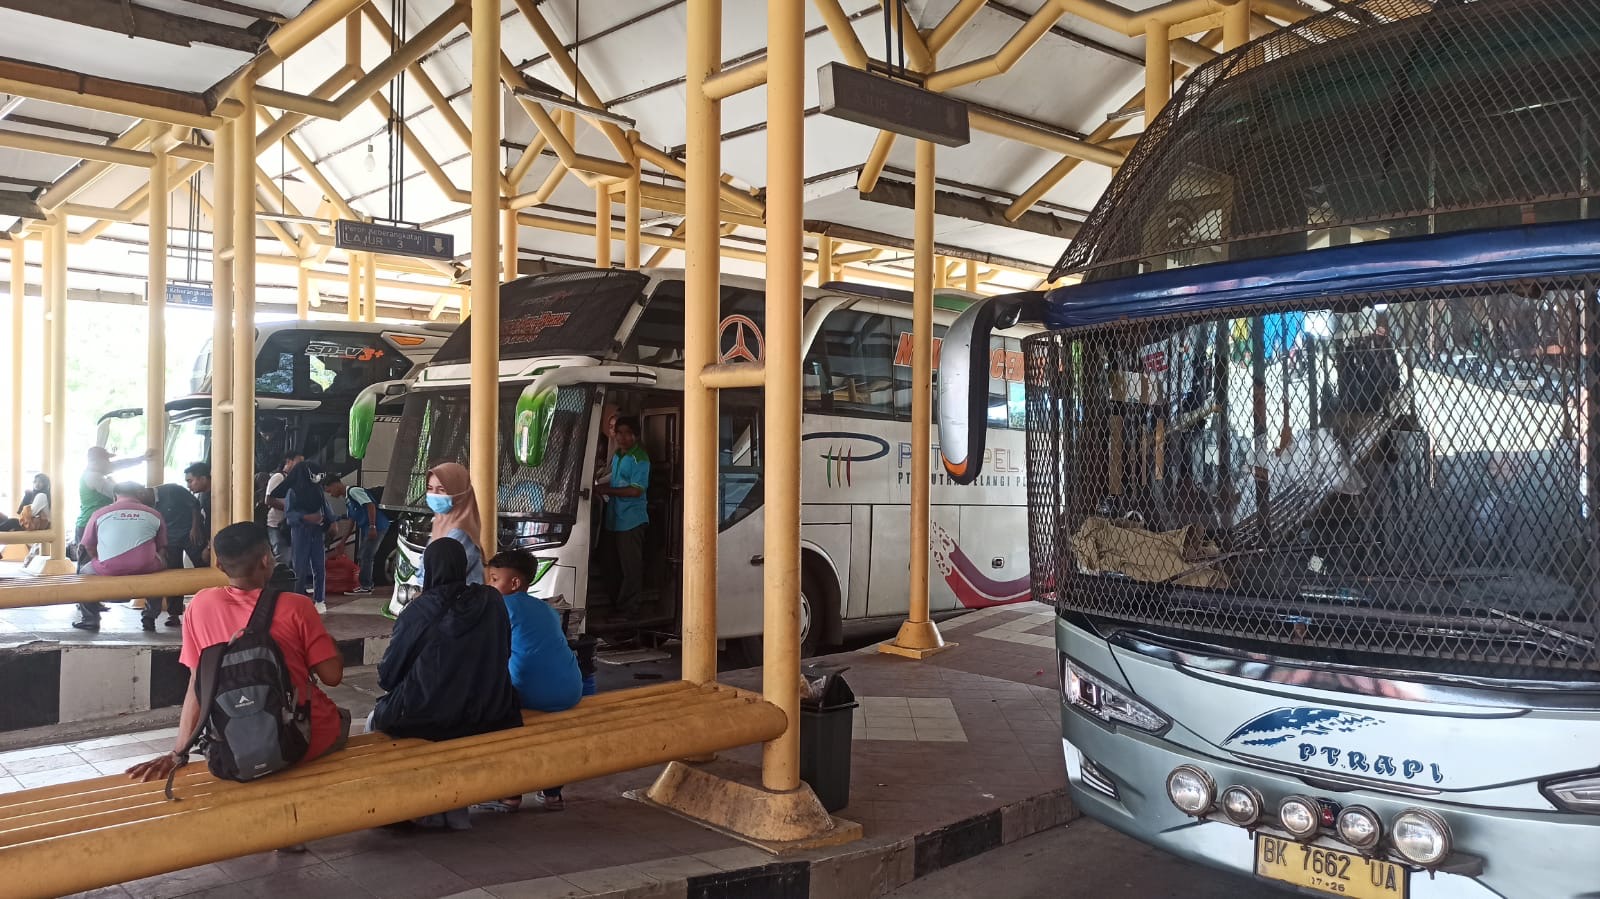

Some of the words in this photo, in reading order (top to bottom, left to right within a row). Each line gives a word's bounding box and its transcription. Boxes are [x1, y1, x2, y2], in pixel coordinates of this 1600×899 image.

[396, 239, 404, 249] 3
[1263, 837, 1289, 867] BK
[1300, 845, 1351, 881] 7662
[1371, 860, 1397, 892] UA
